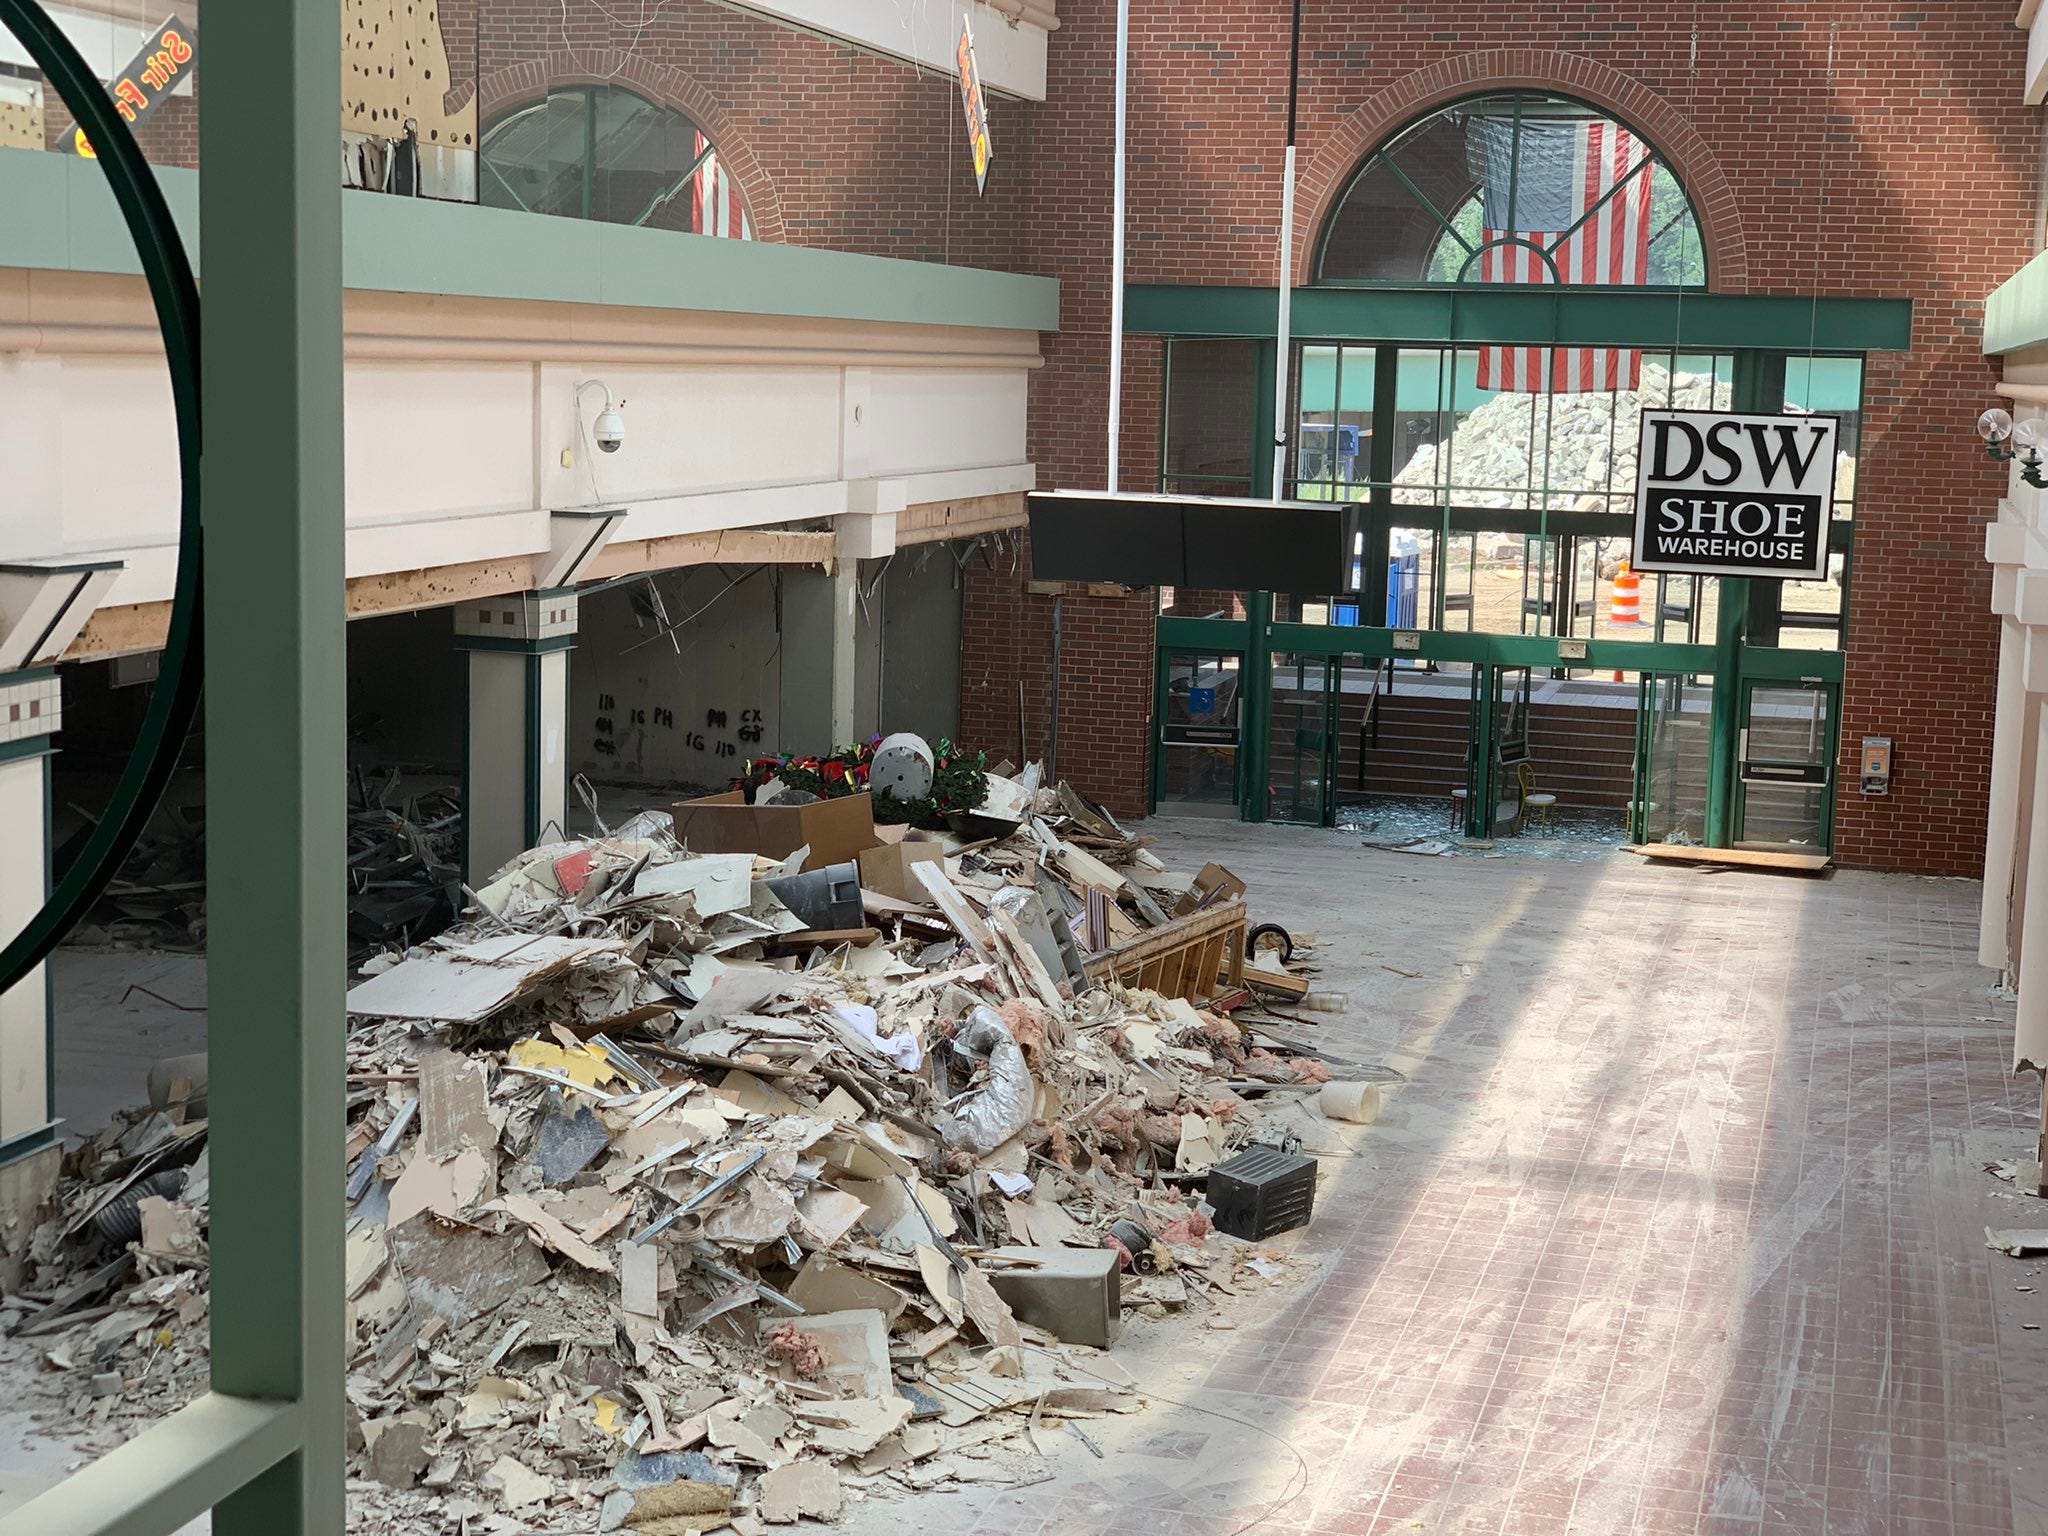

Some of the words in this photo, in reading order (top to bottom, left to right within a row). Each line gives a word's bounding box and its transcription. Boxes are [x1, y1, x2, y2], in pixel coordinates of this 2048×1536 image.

[1647, 420, 1828, 489] DSW
[1658, 498, 1805, 538] SHOE
[1657, 536, 1803, 561] WAREHOUSE
